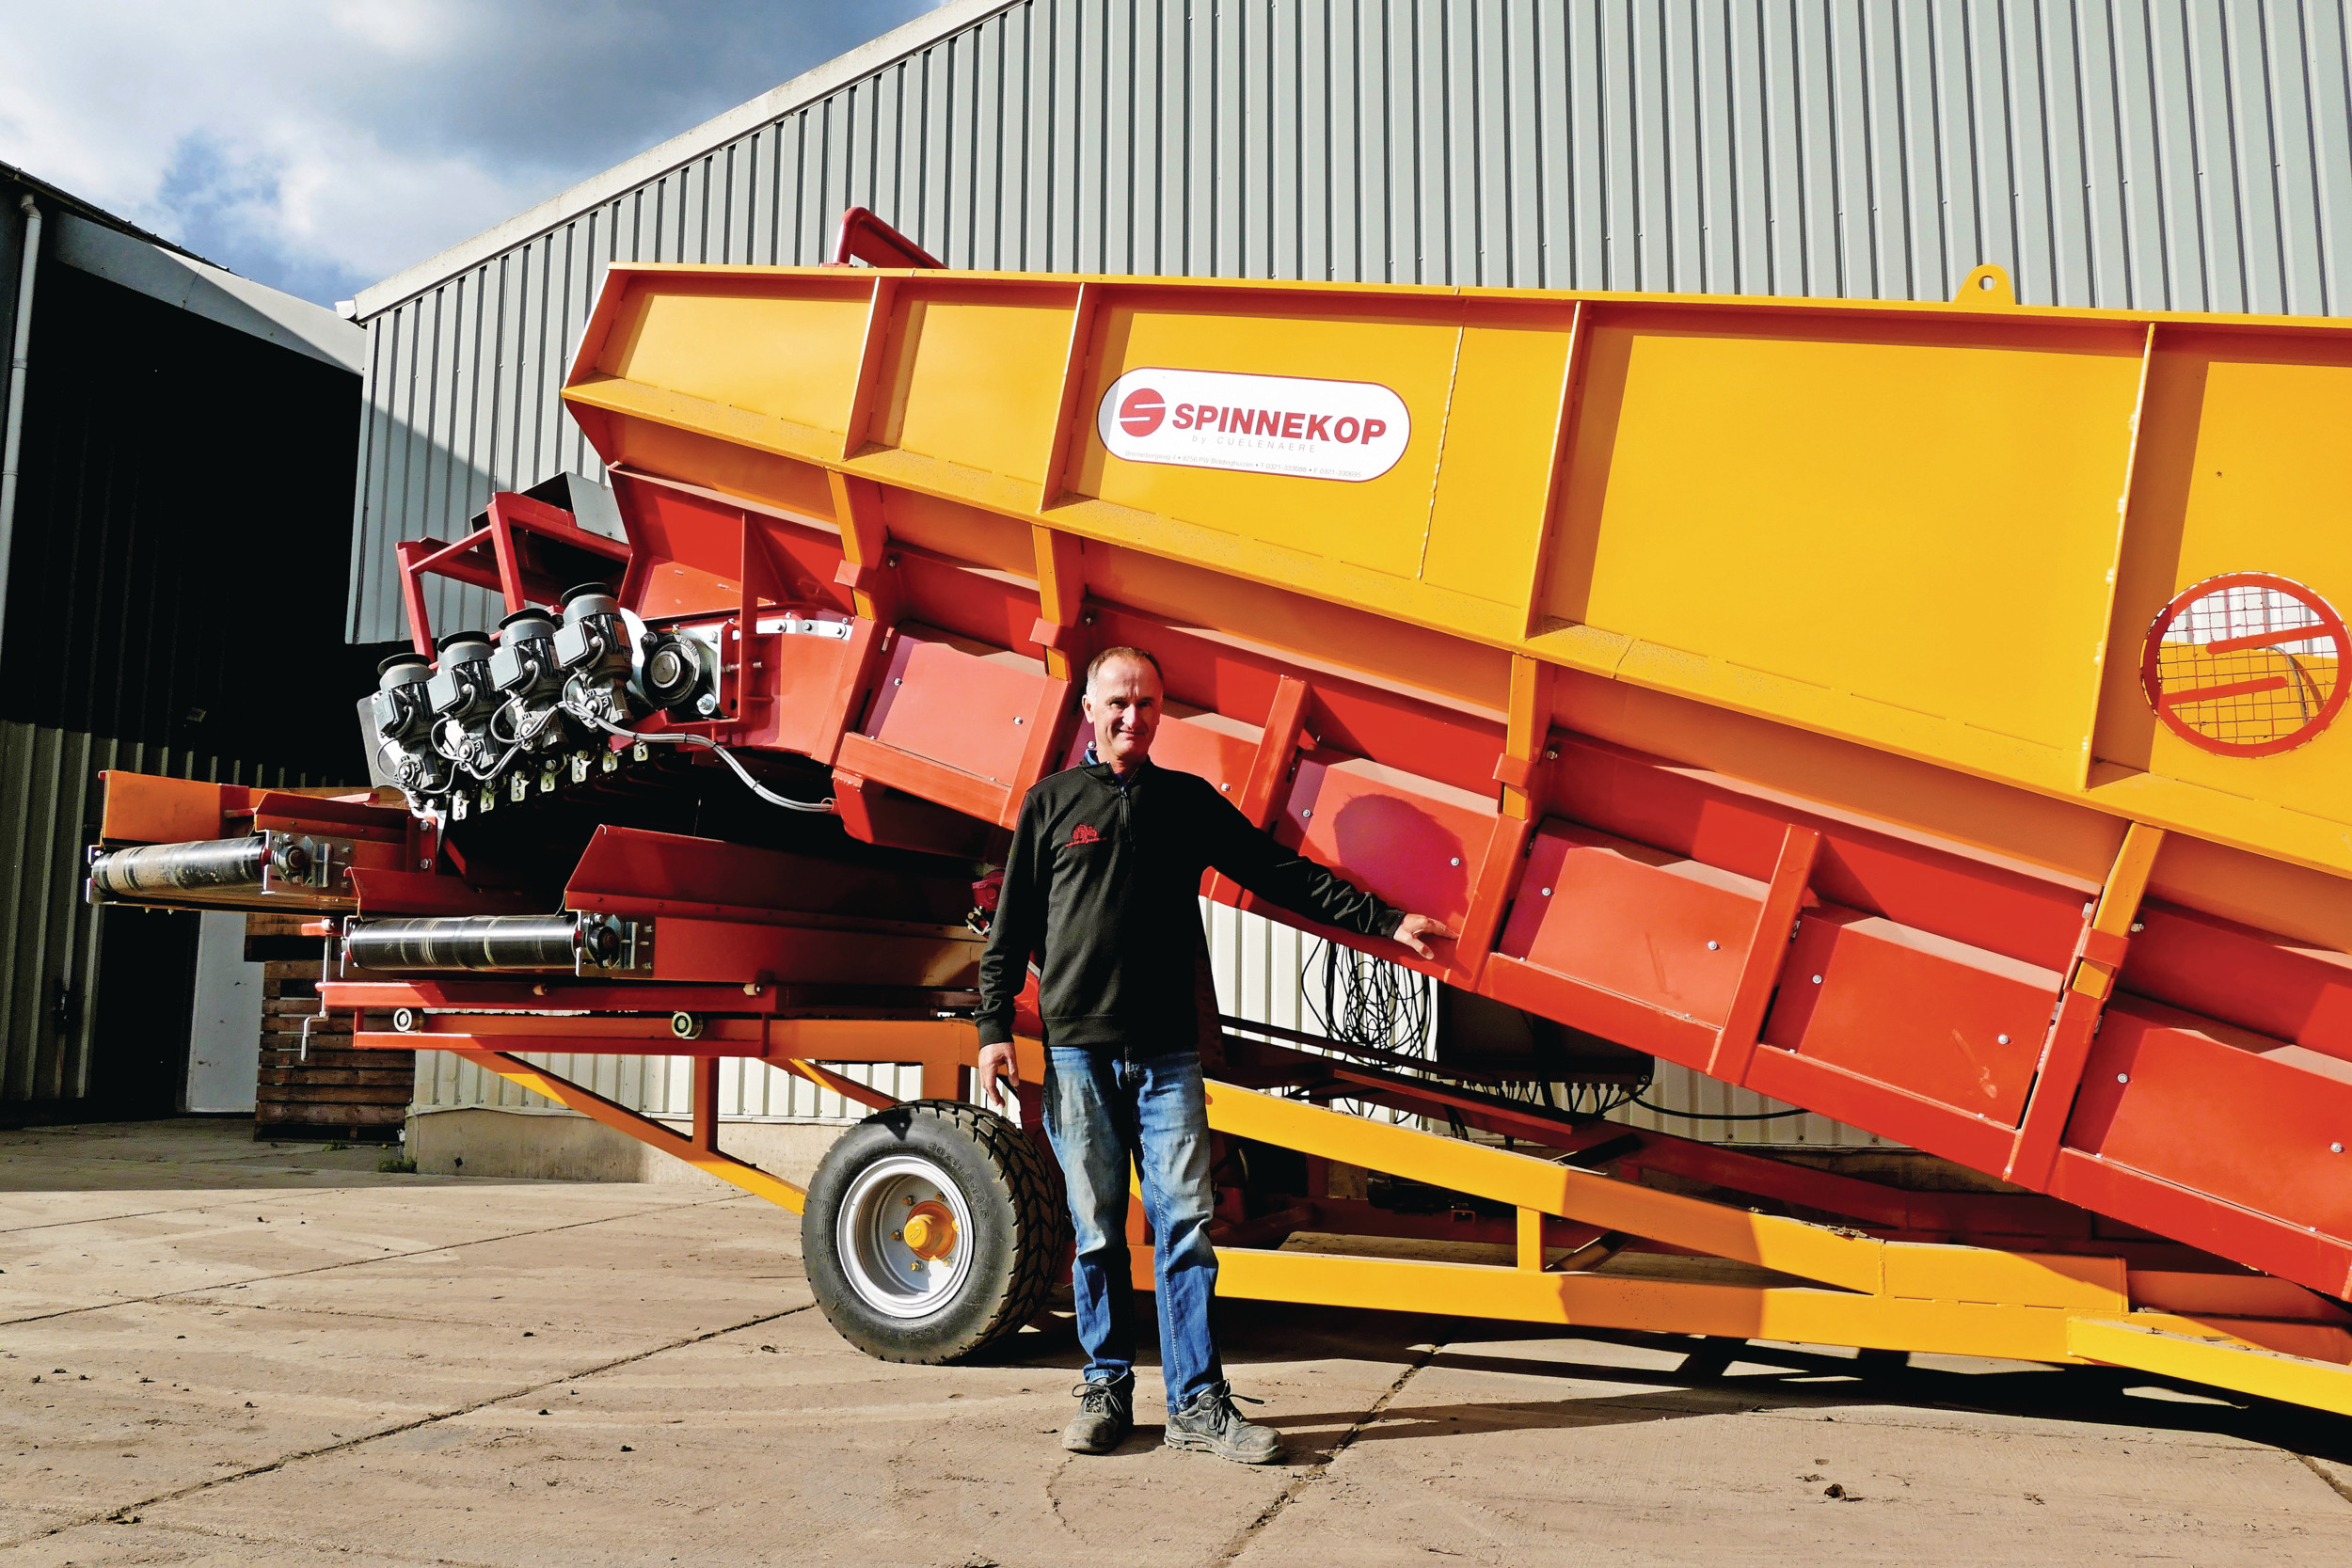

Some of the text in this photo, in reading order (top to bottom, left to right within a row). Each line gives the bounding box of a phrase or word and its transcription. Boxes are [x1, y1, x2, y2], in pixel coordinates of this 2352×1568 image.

[1172, 403, 1387, 445] SPINNEKOP
[1192, 435, 1316, 452] by CUELENAERE
[1211, 457, 1254, 468] Biddinghuizen
